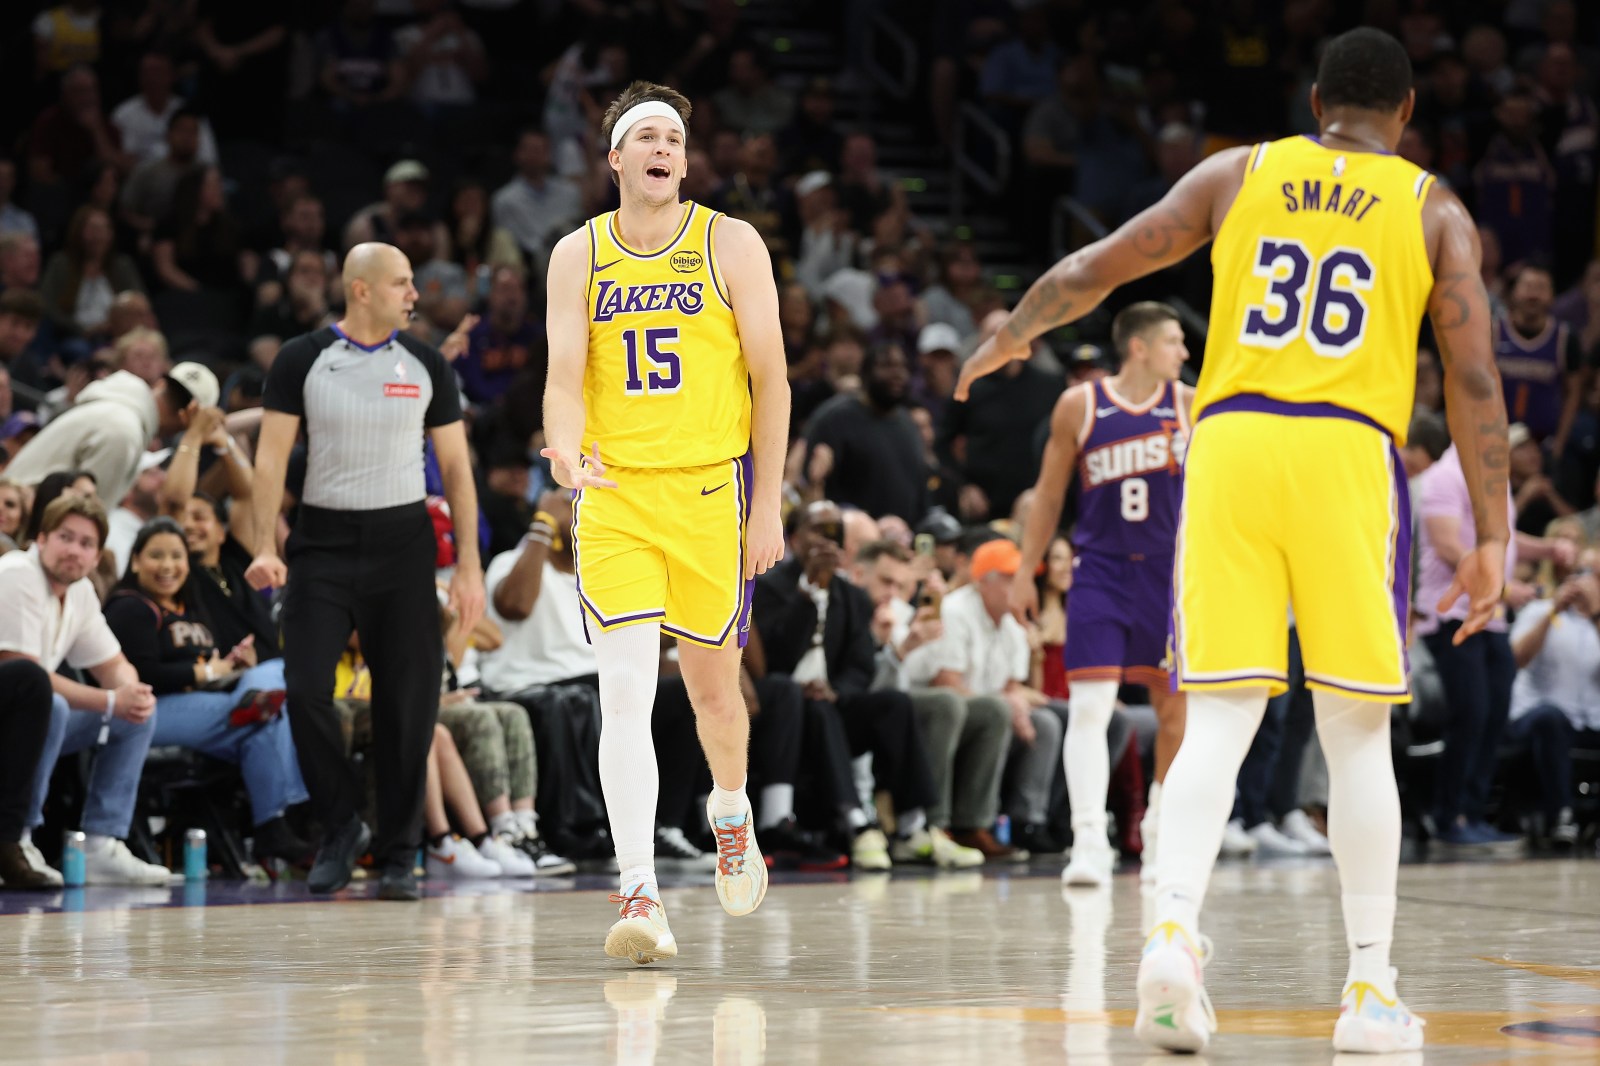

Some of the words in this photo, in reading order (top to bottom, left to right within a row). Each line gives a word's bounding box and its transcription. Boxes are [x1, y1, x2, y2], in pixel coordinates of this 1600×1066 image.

[1282, 179, 1381, 222] SMART
[673, 256, 701, 267] bibigo
[592, 280, 704, 322] LAKERS
[1240, 238, 1374, 356] 36
[622, 327, 683, 394] 15
[1121, 478, 1148, 521] 8
